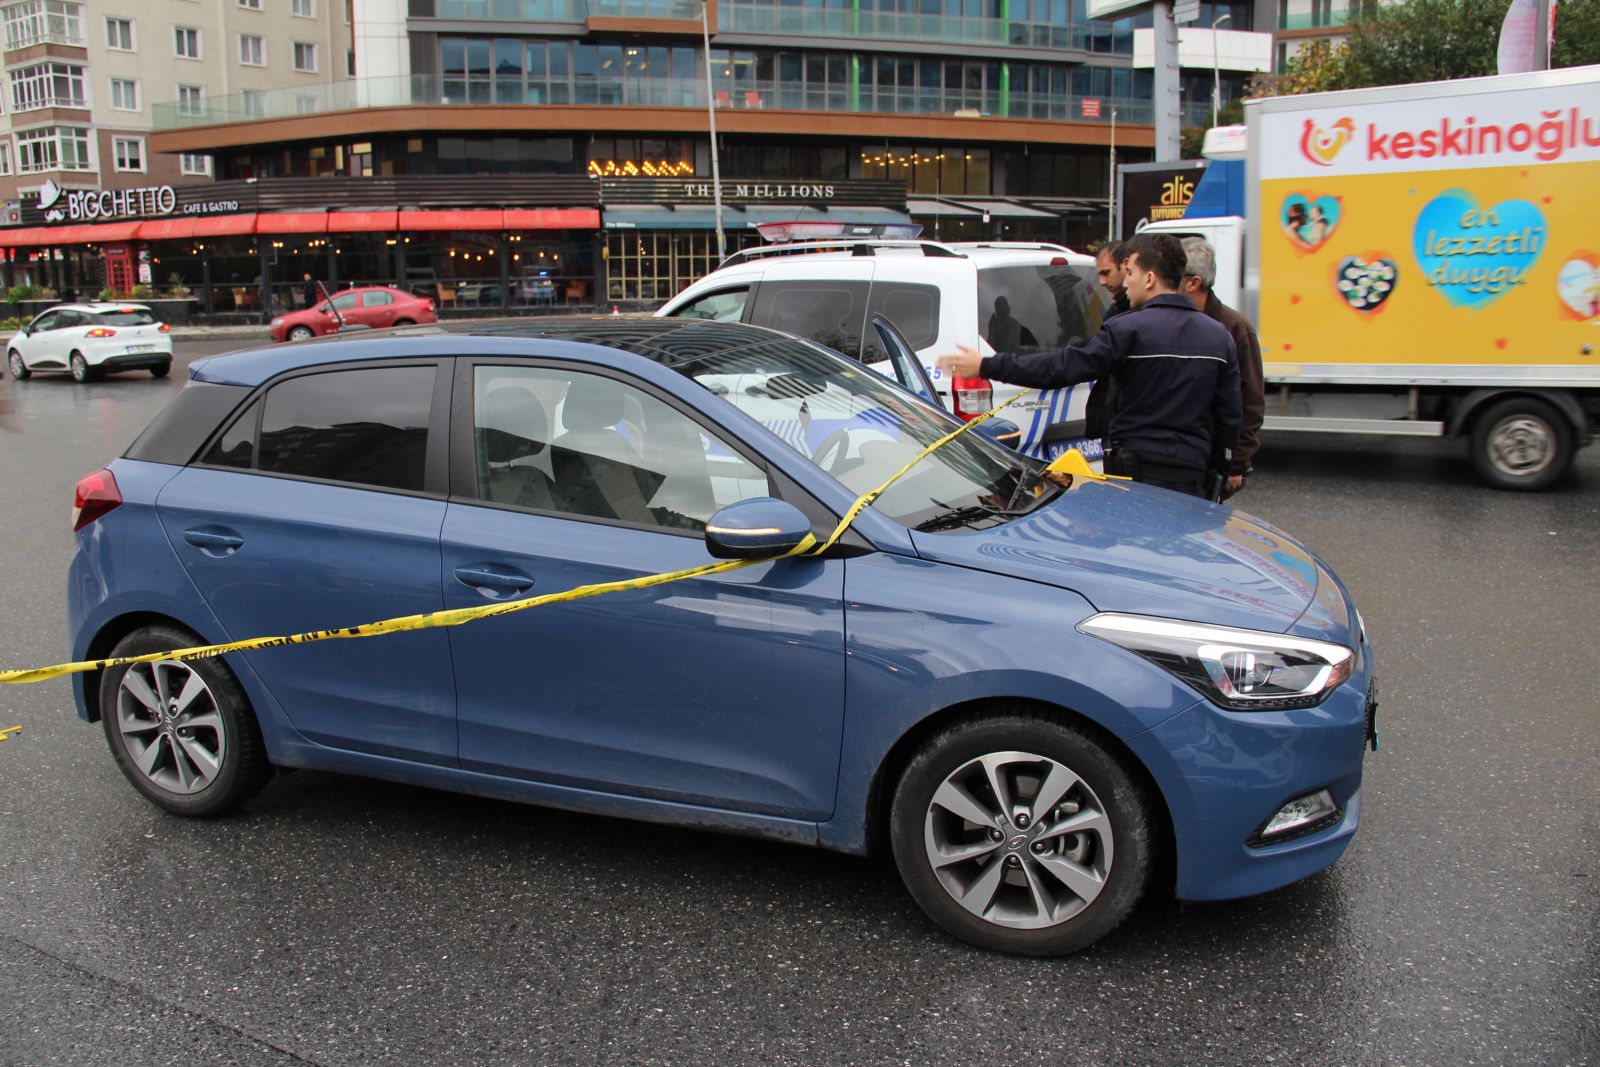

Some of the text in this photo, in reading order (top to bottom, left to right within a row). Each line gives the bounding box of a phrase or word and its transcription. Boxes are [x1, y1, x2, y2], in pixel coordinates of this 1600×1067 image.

[684, 184, 835, 197] TH MILLIONS
[183, 200, 239, 214] CAFE & GASTRO
[1458, 208, 1500, 230] en
[1423, 225, 1543, 257] lezzetli
[1427, 259, 1528, 294] duygu
